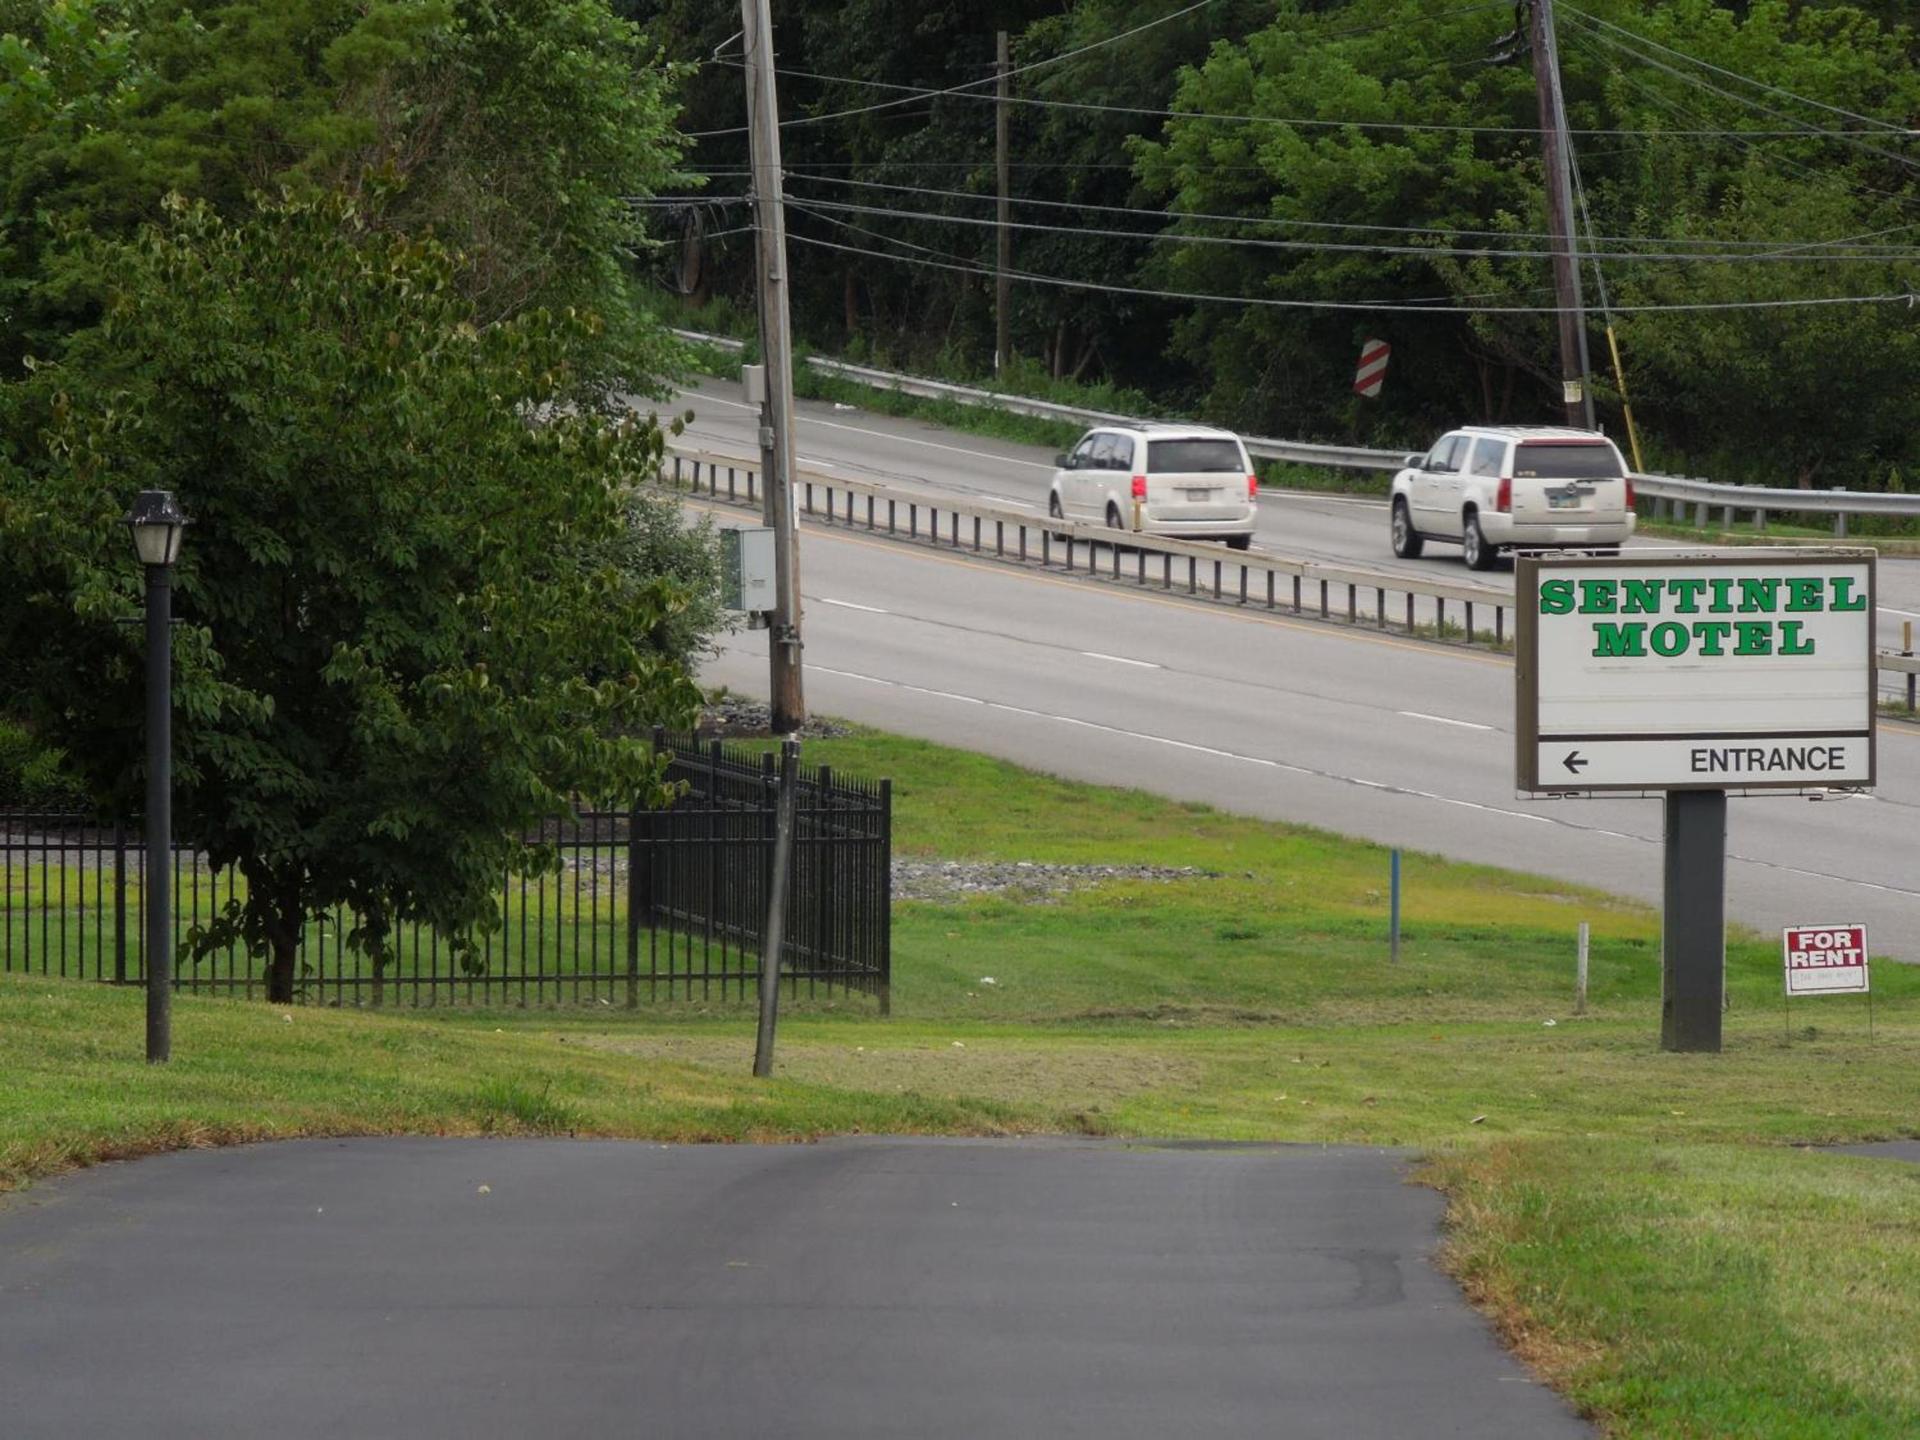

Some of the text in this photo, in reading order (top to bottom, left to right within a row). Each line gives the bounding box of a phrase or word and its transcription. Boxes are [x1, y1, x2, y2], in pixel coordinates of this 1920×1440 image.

[1540, 577, 1866, 614] SENTINEL
[1592, 621, 1815, 657] MOTEL
[1691, 746, 1845, 772] ENTRANCE
[1798, 932, 1852, 949] FOR
[1791, 949, 1861, 967] RENT
